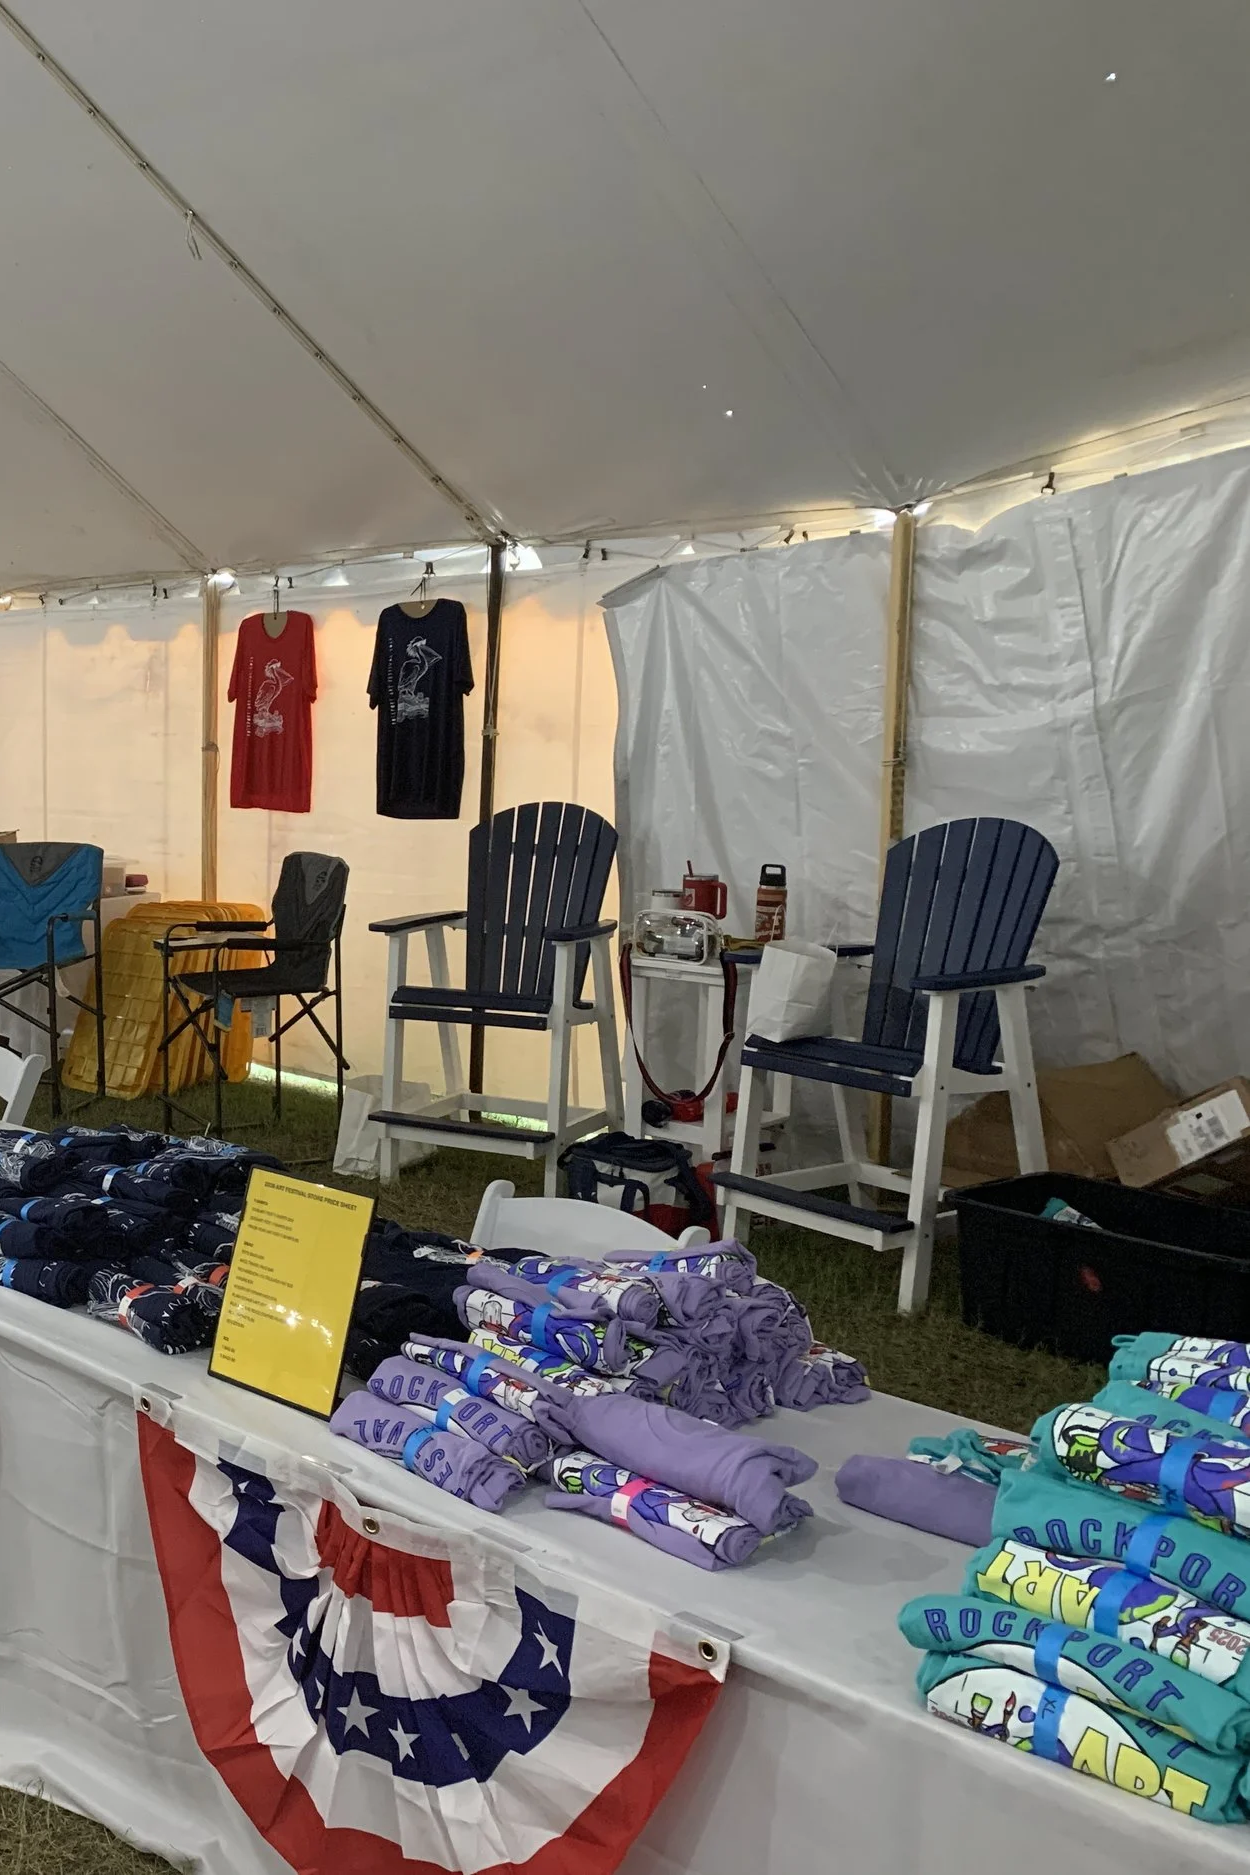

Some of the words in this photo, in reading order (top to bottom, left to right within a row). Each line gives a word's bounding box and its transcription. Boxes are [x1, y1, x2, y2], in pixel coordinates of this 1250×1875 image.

[370, 1374, 513, 1446] ROCKORT
[977, 1550, 1101, 1629] ART
[1013, 1518, 1248, 1611] ROCKPOR
[1041, 1697, 1057, 1719] XL
